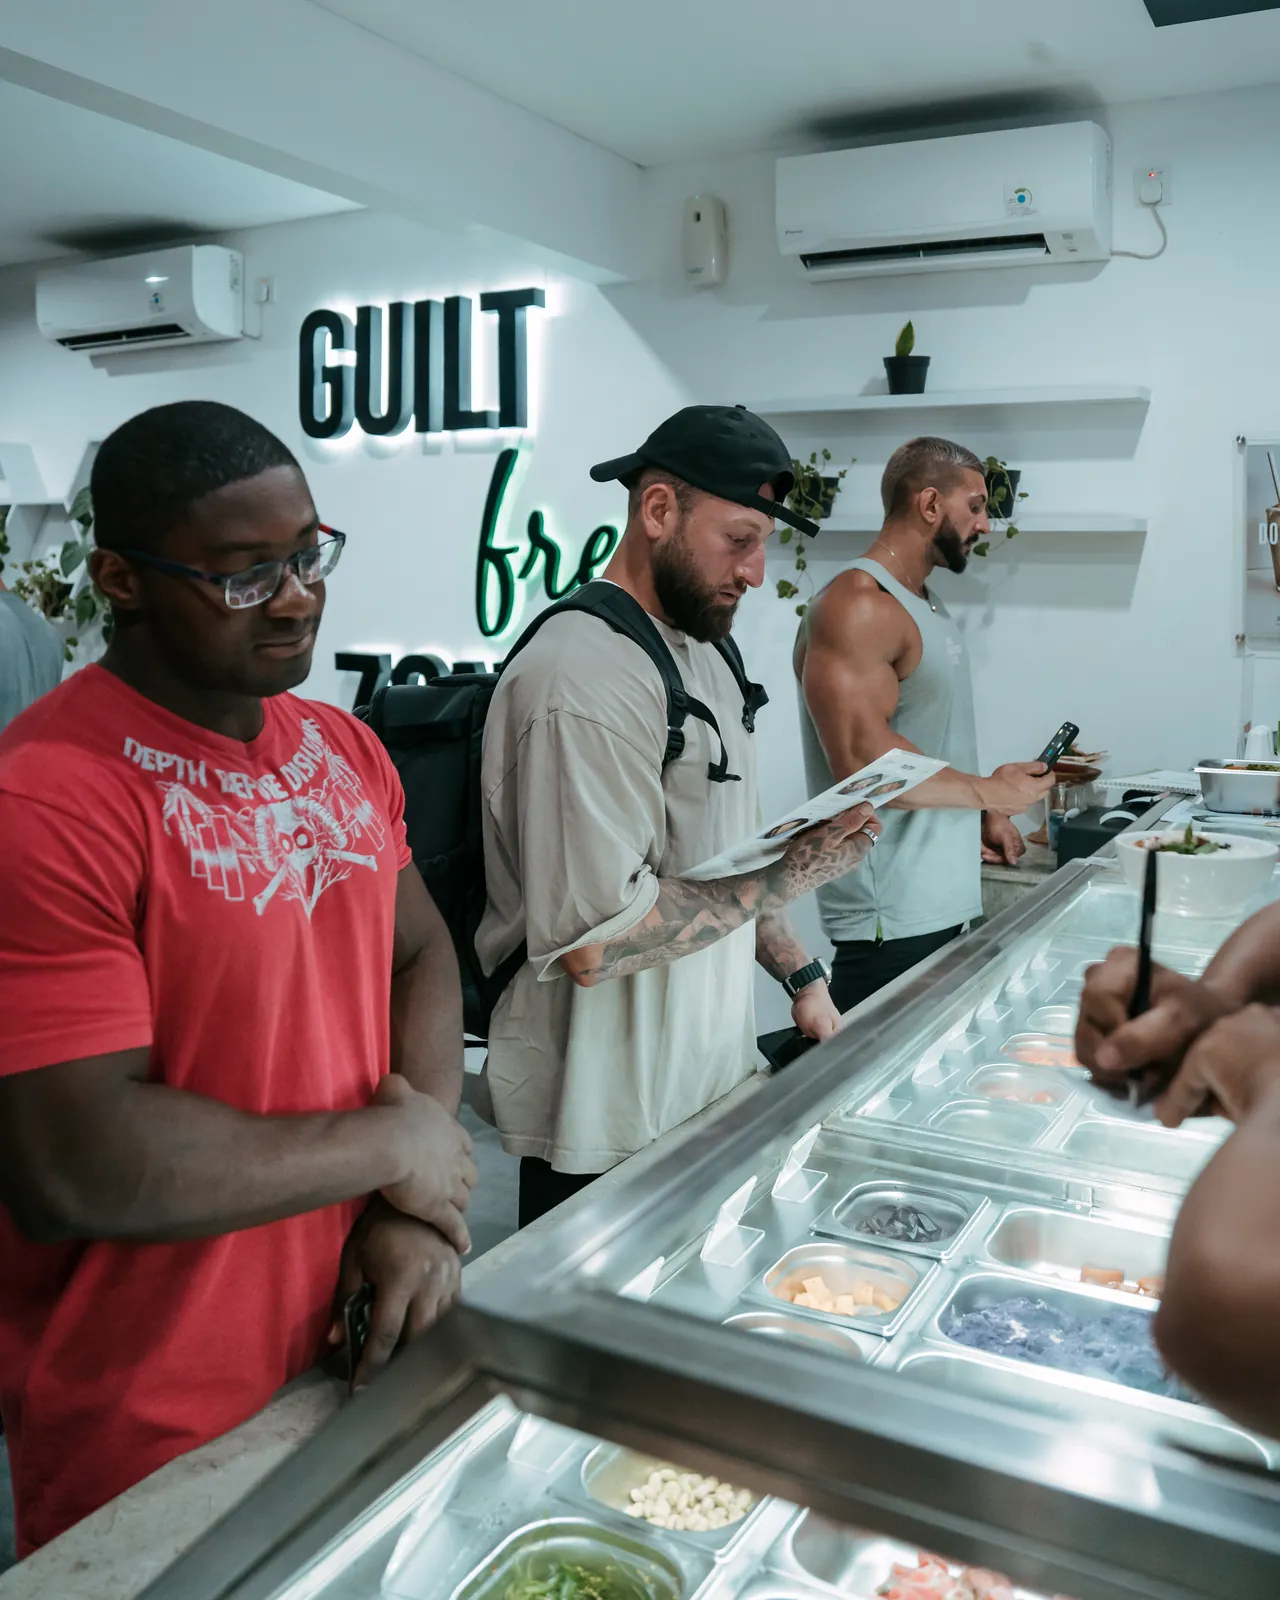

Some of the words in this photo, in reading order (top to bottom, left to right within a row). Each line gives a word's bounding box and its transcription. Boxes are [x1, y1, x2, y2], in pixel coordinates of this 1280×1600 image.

[299, 287, 546, 440] GUILT
[475, 448, 619, 637] fre
[123, 735, 208, 788] DEPTH
